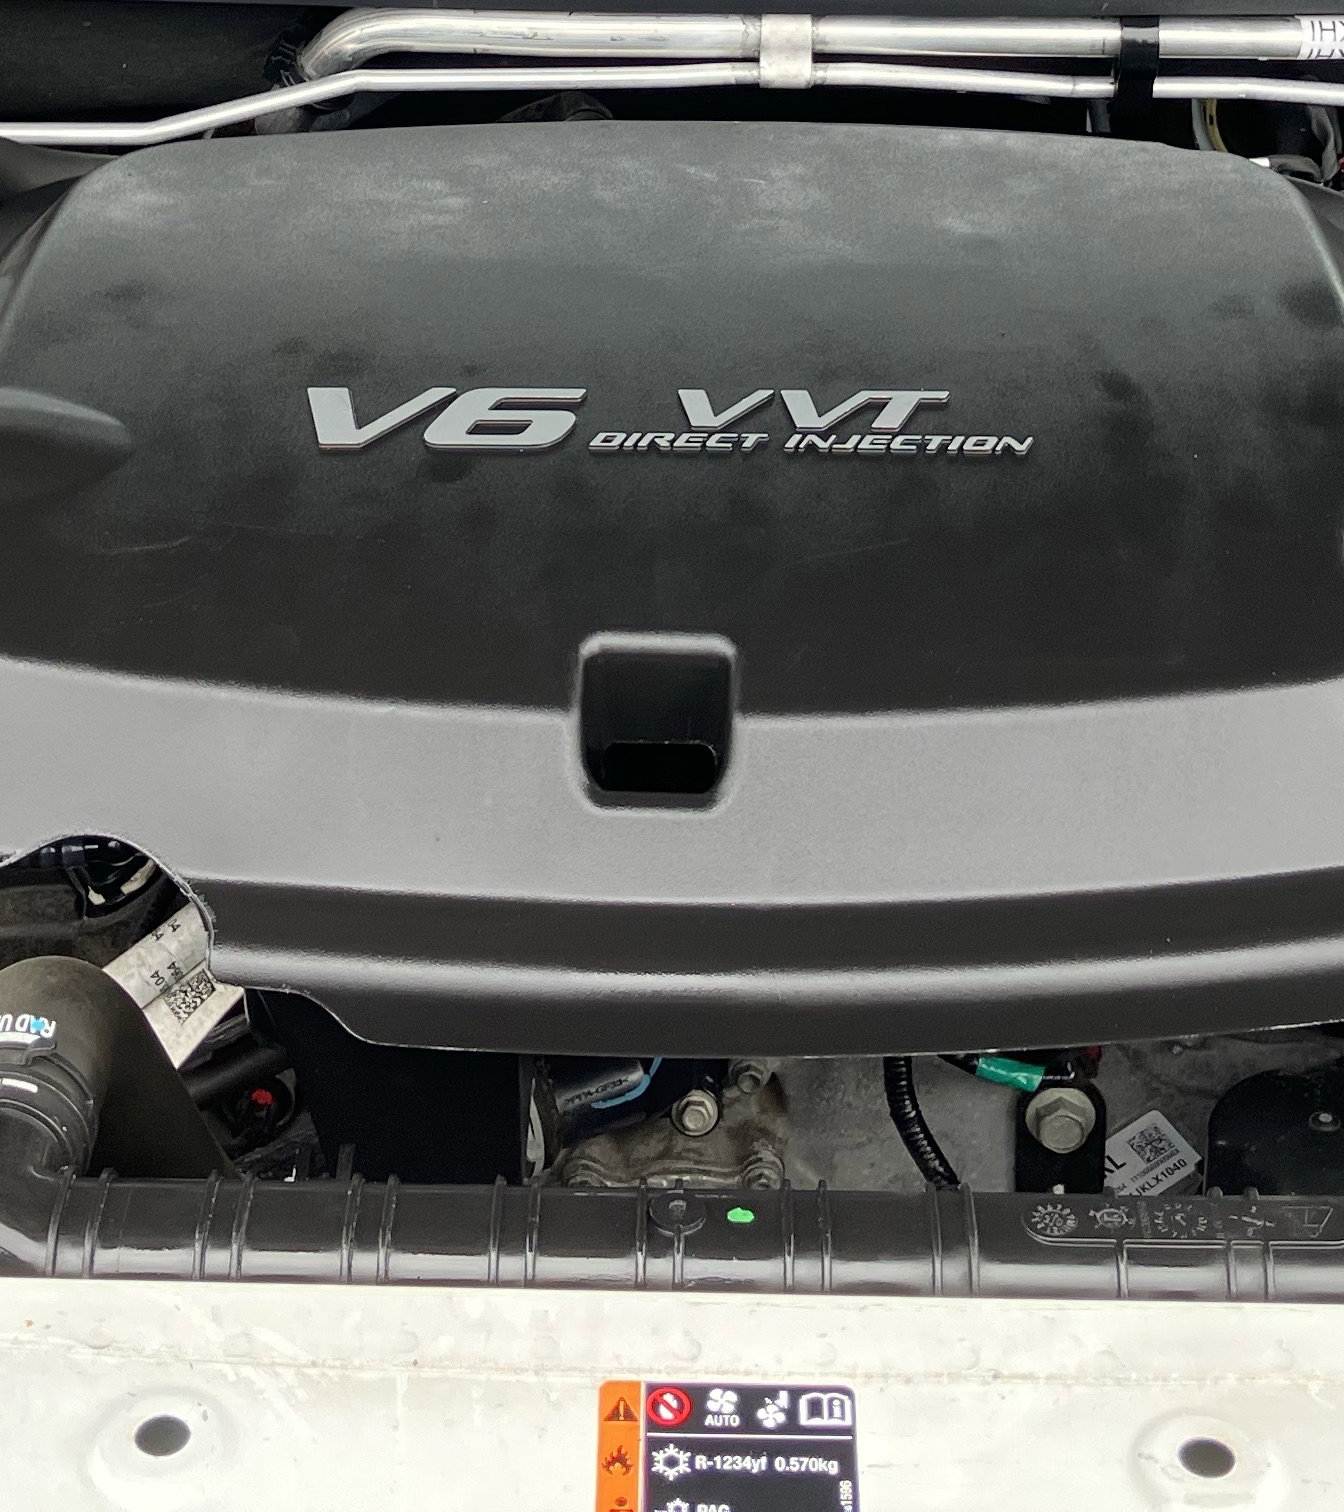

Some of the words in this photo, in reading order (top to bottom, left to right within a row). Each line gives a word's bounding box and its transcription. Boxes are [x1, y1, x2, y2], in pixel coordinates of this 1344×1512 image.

[307, 386, 587, 450] V6
[678, 388, 951, 433] VVT
[588, 431, 769, 453] DIRECT
[783, 433, 1035, 455] INJECTION
[704, 1414, 741, 1427] AUTO
[695, 1454, 767, 1473] R-1234yf
[774, 1456, 839, 1475] 0.570kg
